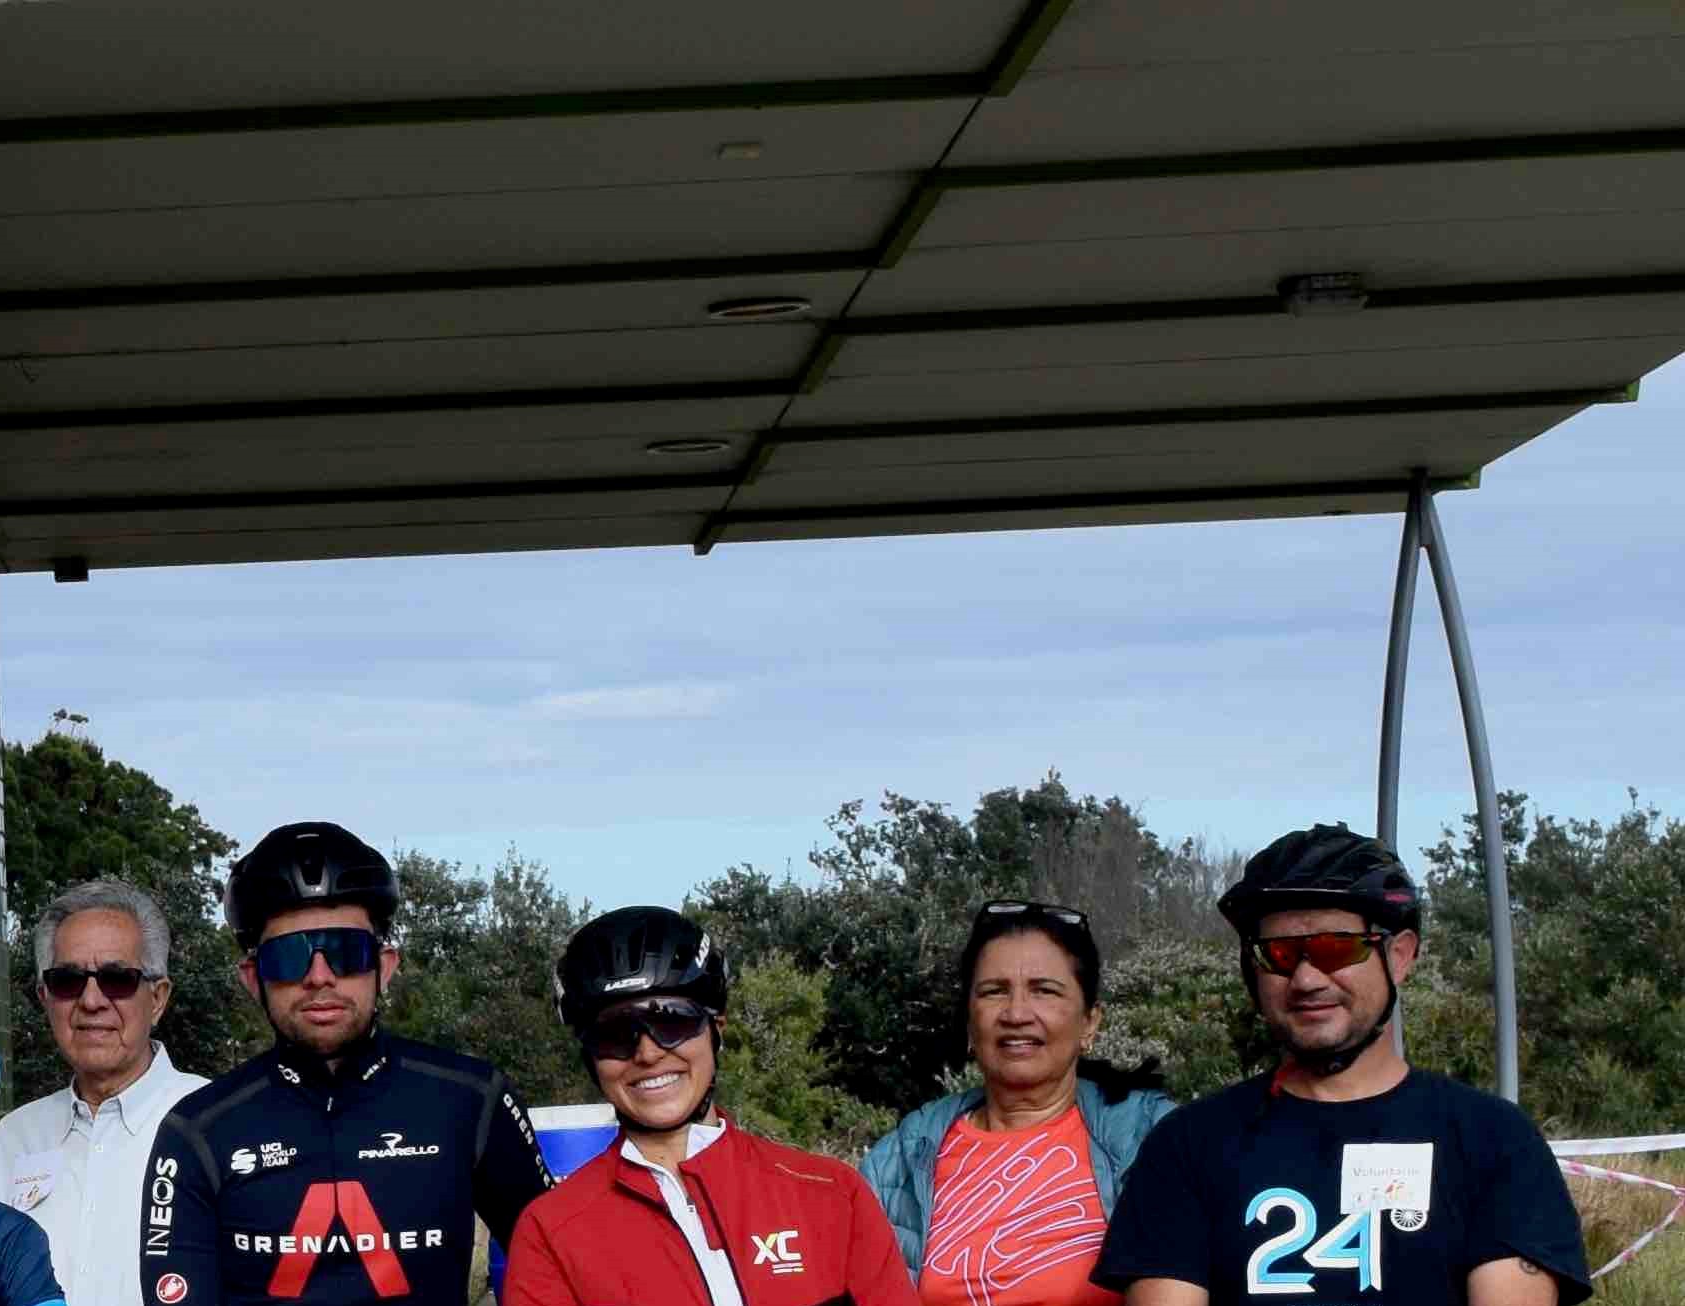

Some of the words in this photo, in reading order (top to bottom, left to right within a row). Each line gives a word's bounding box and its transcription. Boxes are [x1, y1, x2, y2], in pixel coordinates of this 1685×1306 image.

[260, 1142, 282, 1153] UCI
[358, 1144, 440, 1159] PINARELLO
[145, 1157, 179, 1256] INEOS
[234, 1229, 443, 1254] GRENADIER
[750, 1230, 802, 1265] XC
